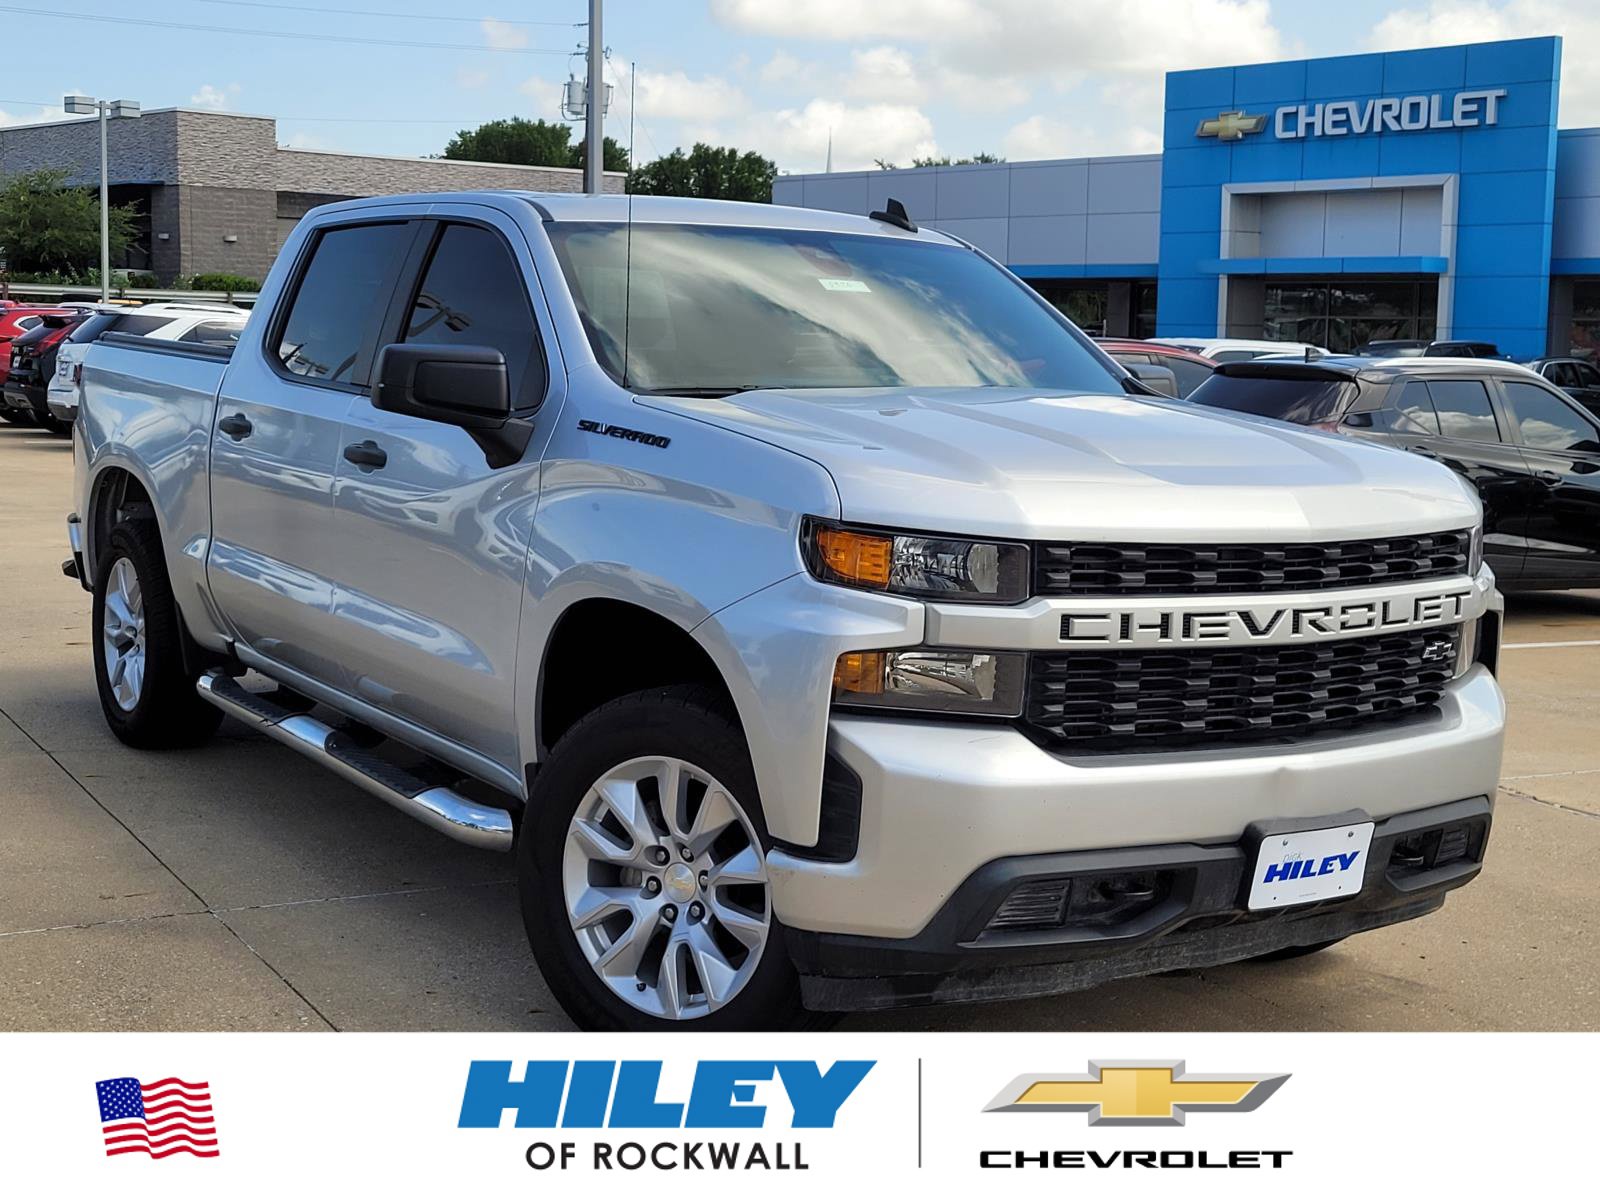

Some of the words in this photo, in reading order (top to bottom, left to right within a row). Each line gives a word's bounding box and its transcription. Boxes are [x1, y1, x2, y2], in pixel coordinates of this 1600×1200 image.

[1275, 89, 1507, 139] CHEVROLET
[577, 419, 671, 449] SILVERADO
[1059, 593, 1472, 643] CHEVROLET
[1263, 850, 1360, 883] HILEY
